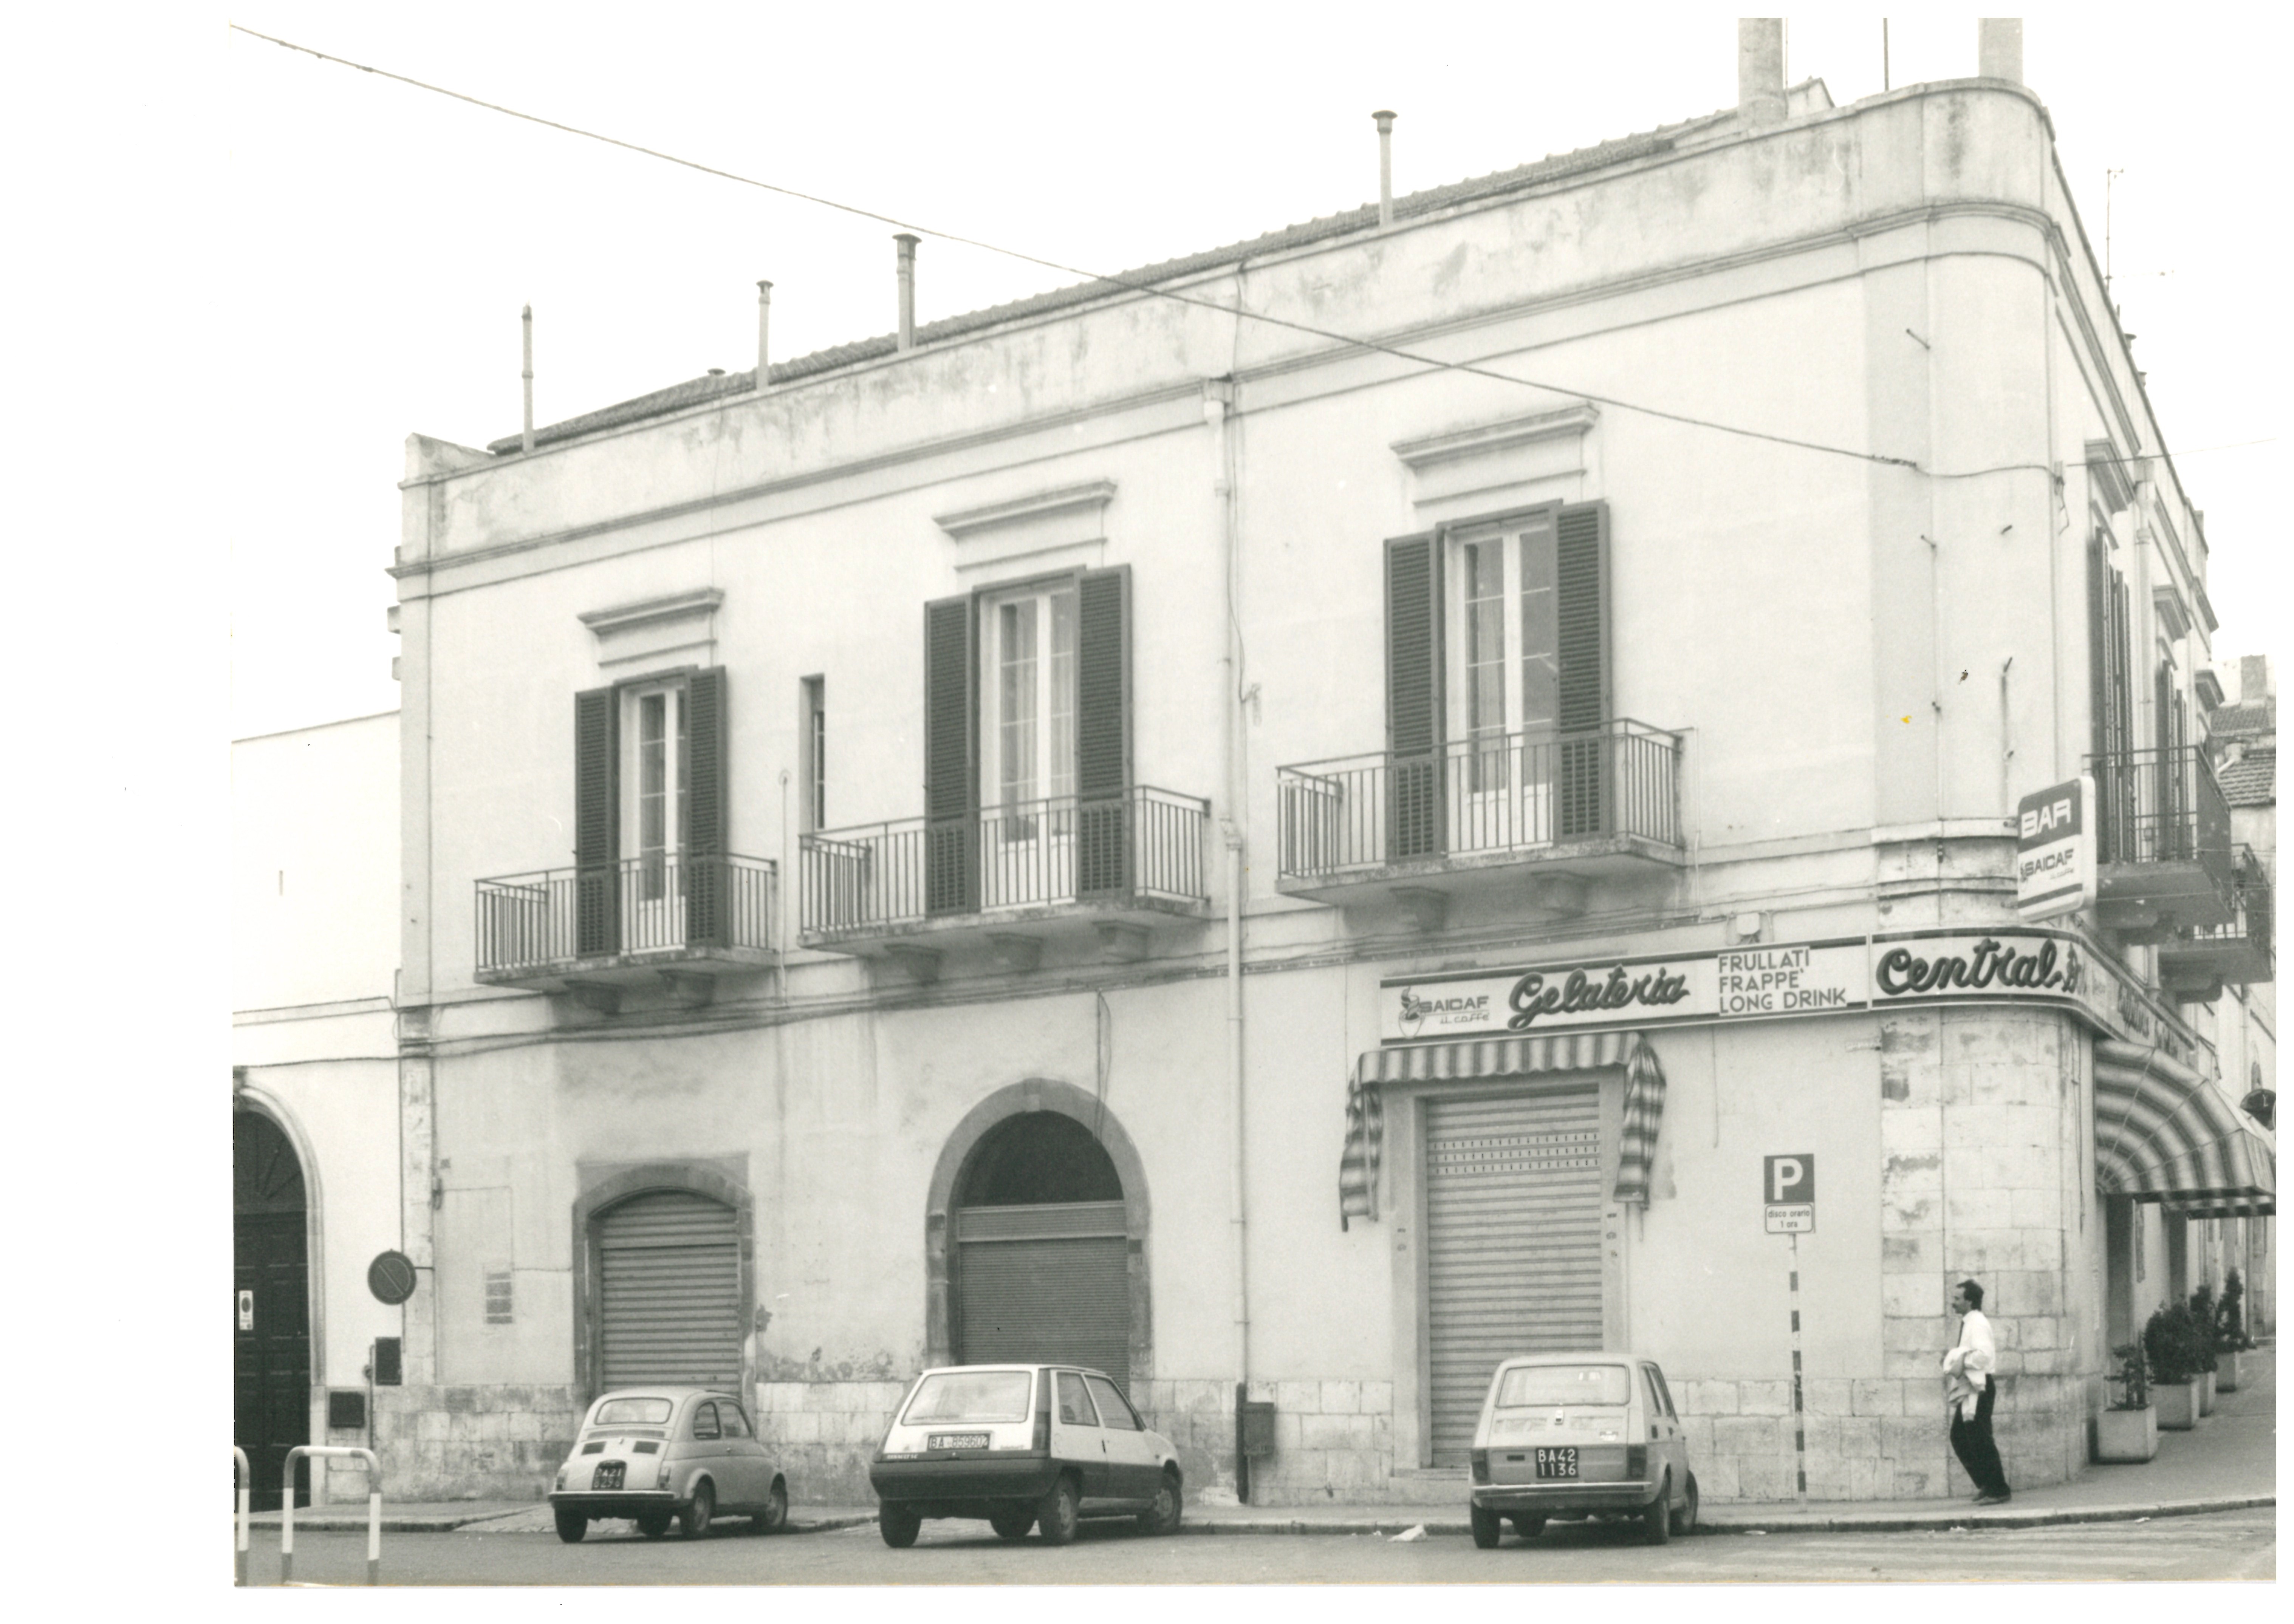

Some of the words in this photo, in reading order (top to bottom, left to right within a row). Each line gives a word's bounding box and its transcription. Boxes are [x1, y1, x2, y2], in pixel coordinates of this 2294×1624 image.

[2021, 798, 2071, 840] BAR
[2025, 848, 2074, 877] SAICAF
[1719, 949, 1809, 973] FRULLATI
[1876, 937, 2062, 995] Central
[1419, 995, 1489, 1013] SAICAF
[1508, 964, 1690, 1031] Gelateria
[1720, 993, 1772, 1013] LONG
[1784, 988, 1846, 1009] DRINK
[1774, 1158, 1803, 1200] P
[931, 1437, 944, 1448] BA
[1538, 1448, 1576, 1463] BA42
[1541, 1463, 1576, 1476] 1136
